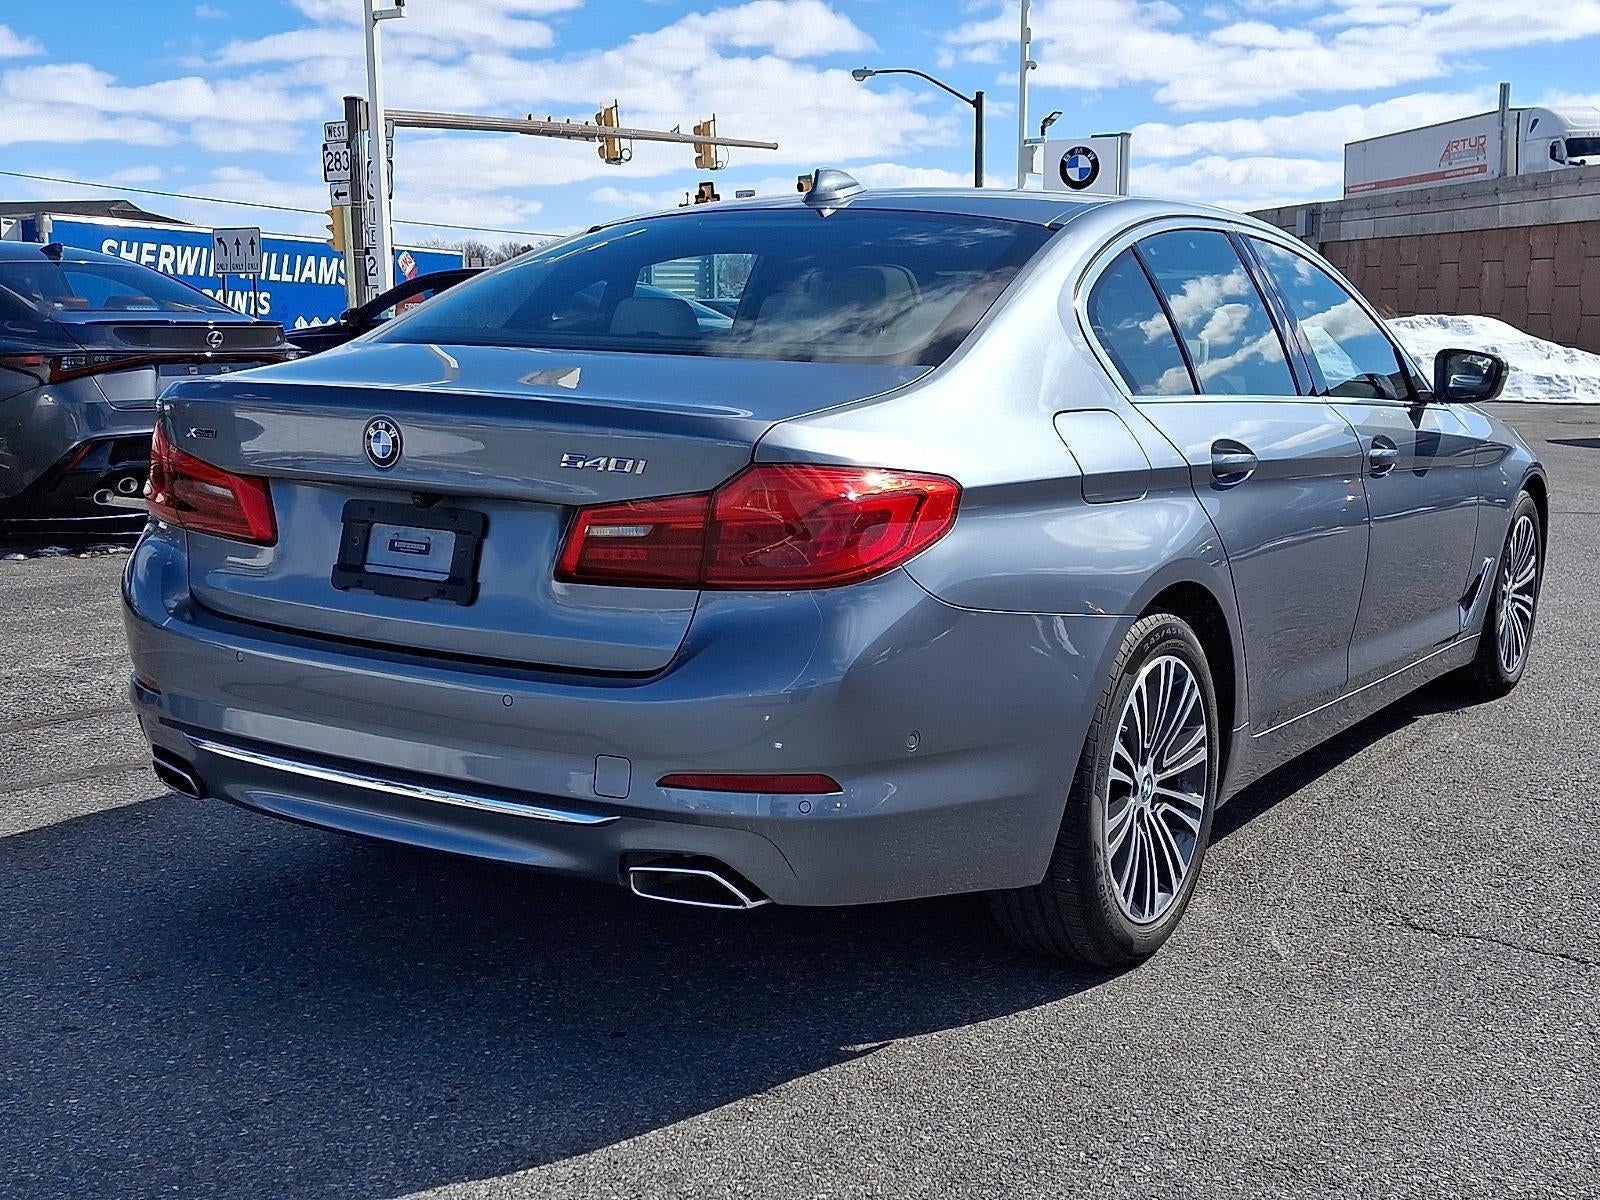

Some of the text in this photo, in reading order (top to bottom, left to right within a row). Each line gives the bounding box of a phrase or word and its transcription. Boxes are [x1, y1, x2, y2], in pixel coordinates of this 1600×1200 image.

[326, 125, 345, 138] WEST
[1063, 147, 1096, 162] BMW
[1440, 135, 1486, 162] ARTUR
[326, 150, 350, 172] 283
[216, 262, 259, 271] ONLY ONLY ONLY
[239, 251, 346, 286] ILLIAMS
[368, 422, 397, 438] BMW
[560, 453, 647, 475] 540i
